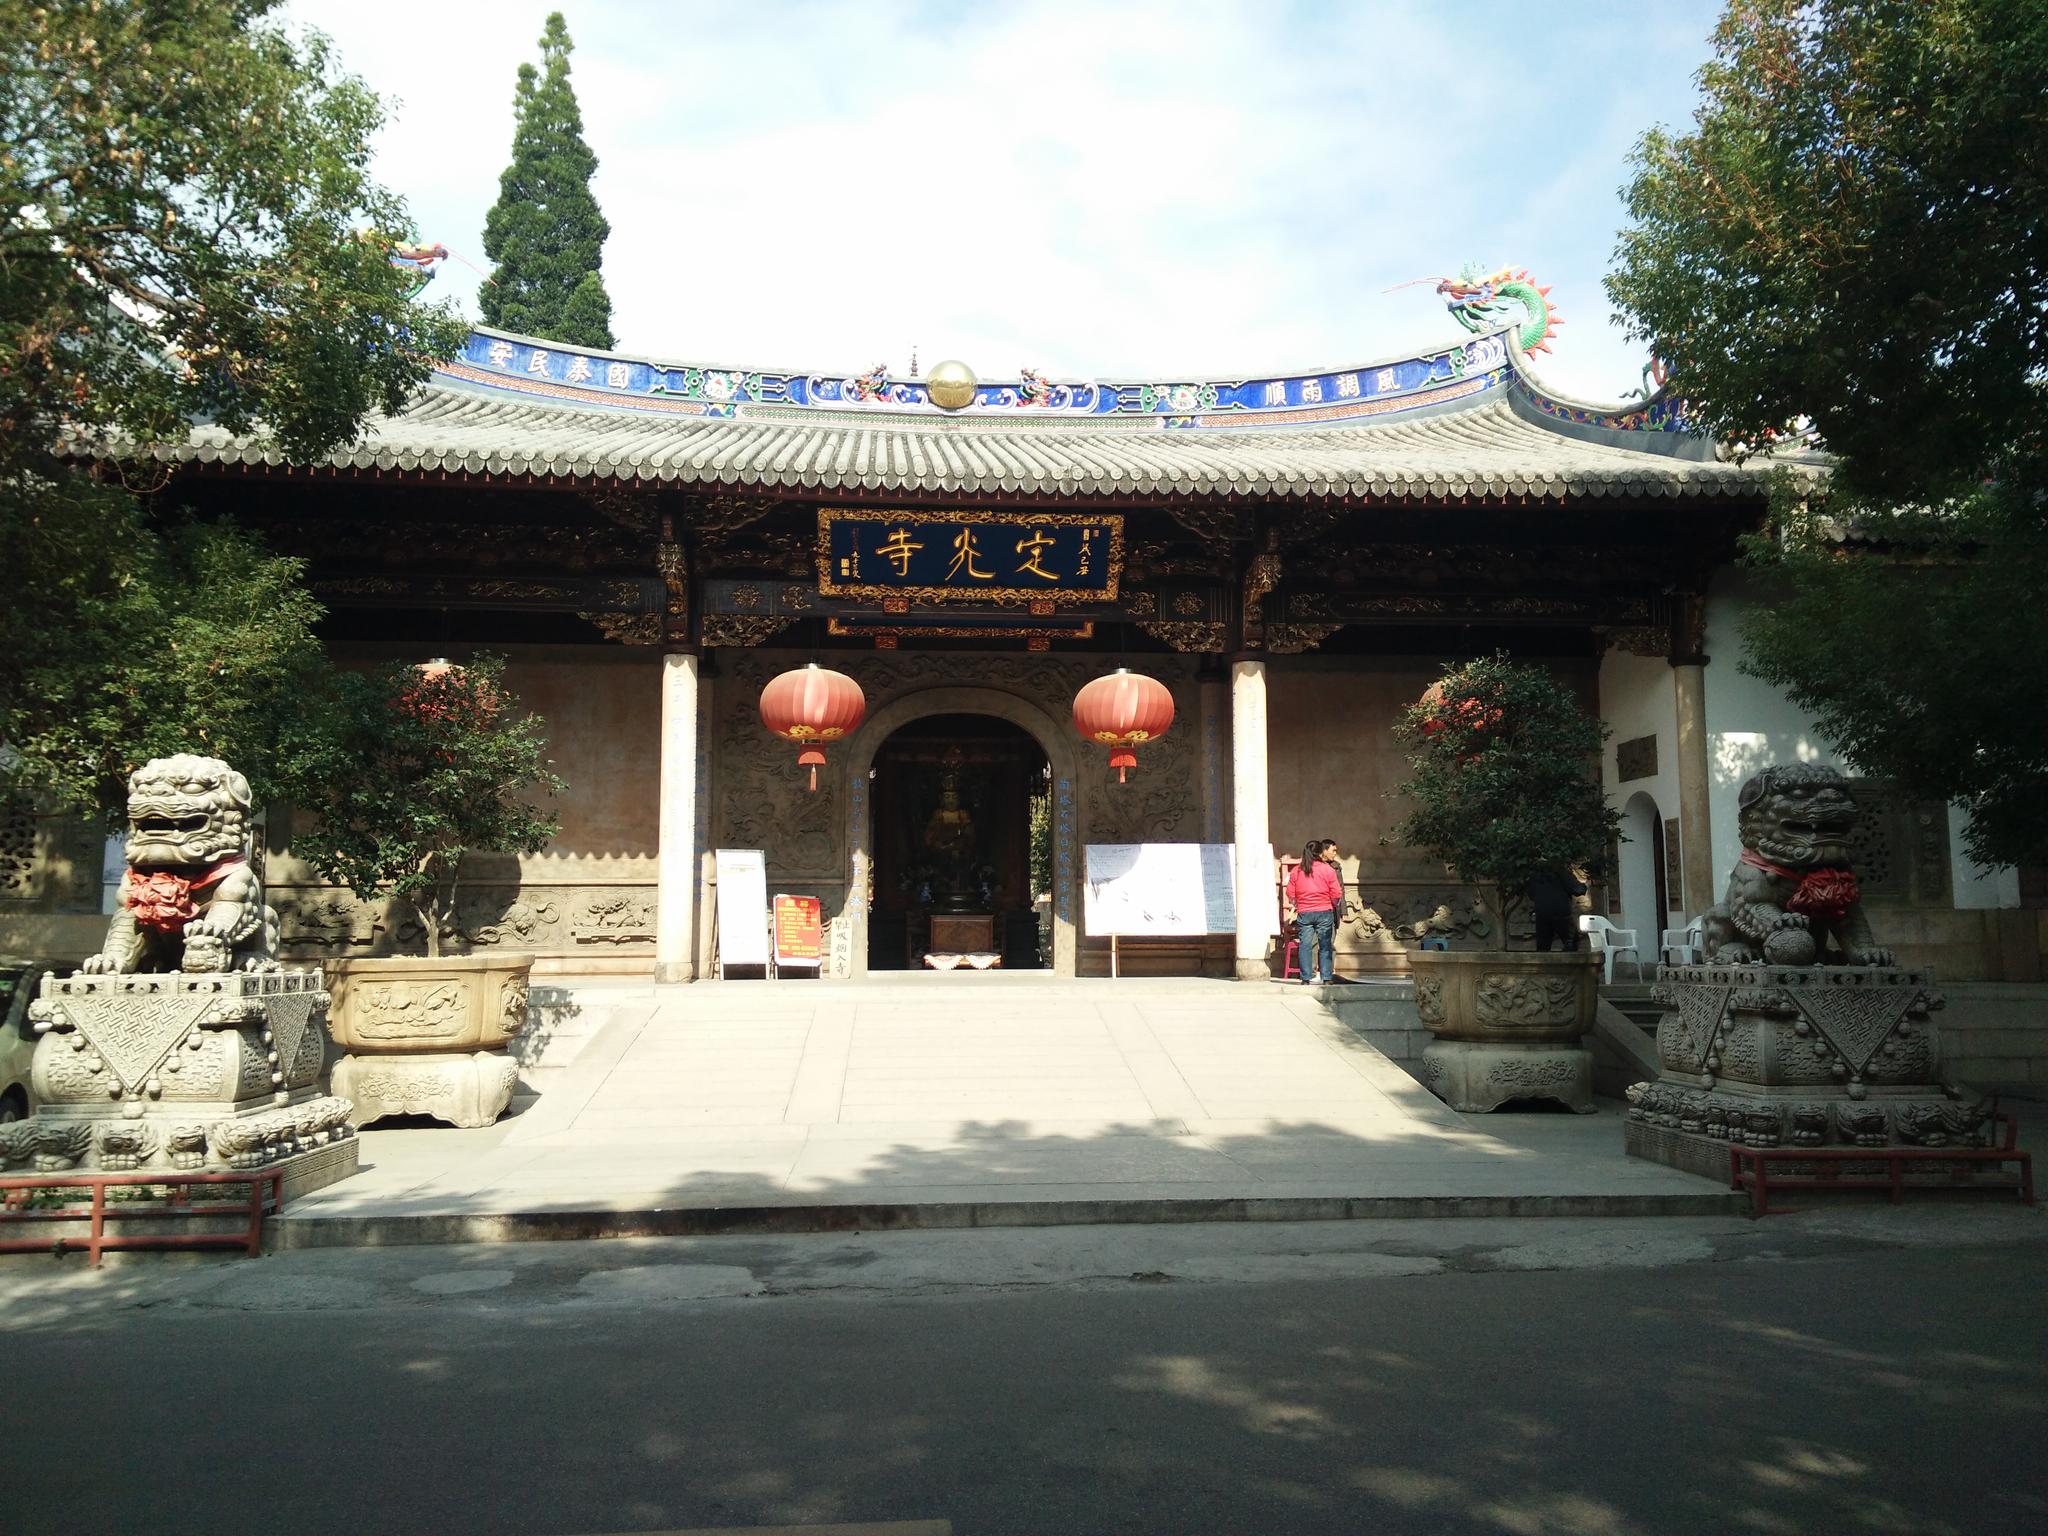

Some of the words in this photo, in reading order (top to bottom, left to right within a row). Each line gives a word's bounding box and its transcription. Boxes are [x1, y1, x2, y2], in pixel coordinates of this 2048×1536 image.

[490, 342, 629, 389] 國泰民安
[1265, 368, 1401, 406] 風調雨順
[876, 527, 1060, 582] 定光寺
